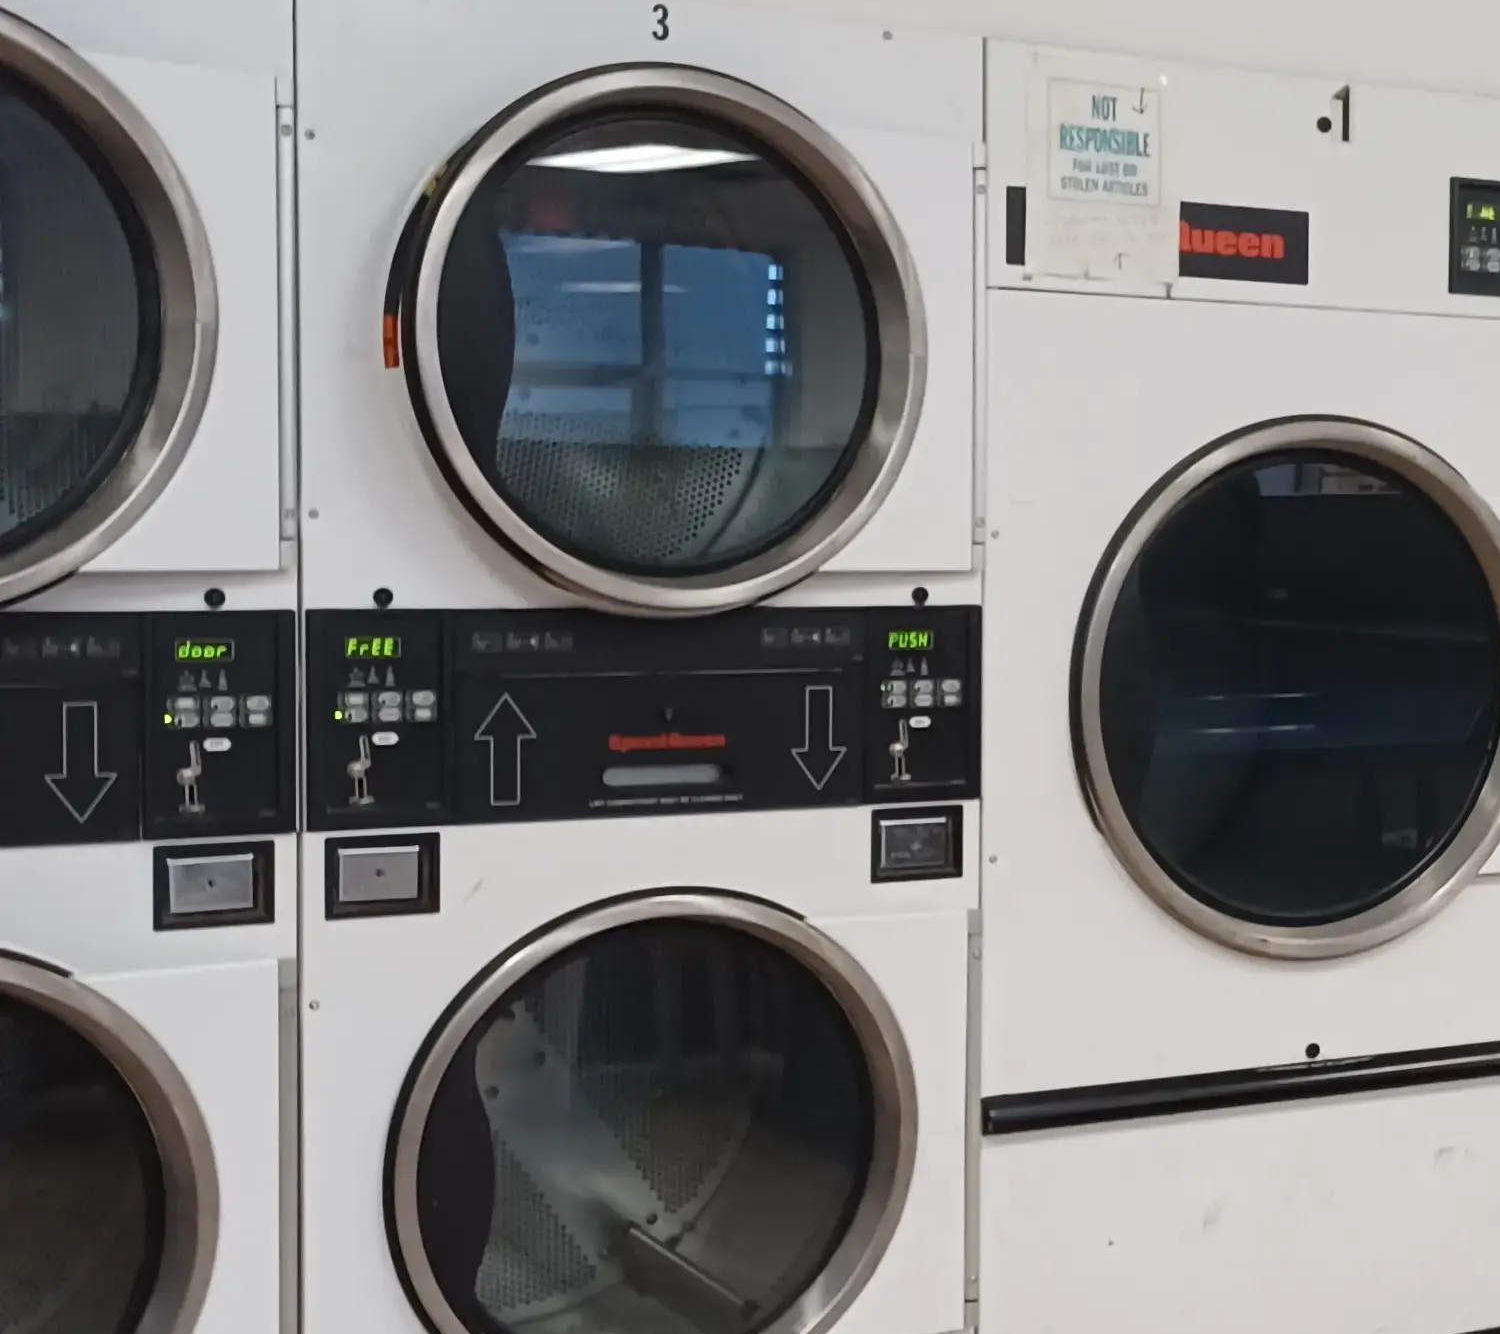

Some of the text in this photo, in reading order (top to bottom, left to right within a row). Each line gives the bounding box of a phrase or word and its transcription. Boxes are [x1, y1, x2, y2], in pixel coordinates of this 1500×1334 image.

[652, 4, 670, 41] 3
[1091, 95, 1118, 122] NOT
[1332, 85, 1350, 142] 1
[1059, 122, 1151, 158] RESPONSIBLE
[1072, 158, 1092, 173] FOR
[1095, 162, 1120, 177] LOST
[1061, 176, 1149, 198] STOLEN ARTICLES
[888, 631, 929, 649] PUSH
